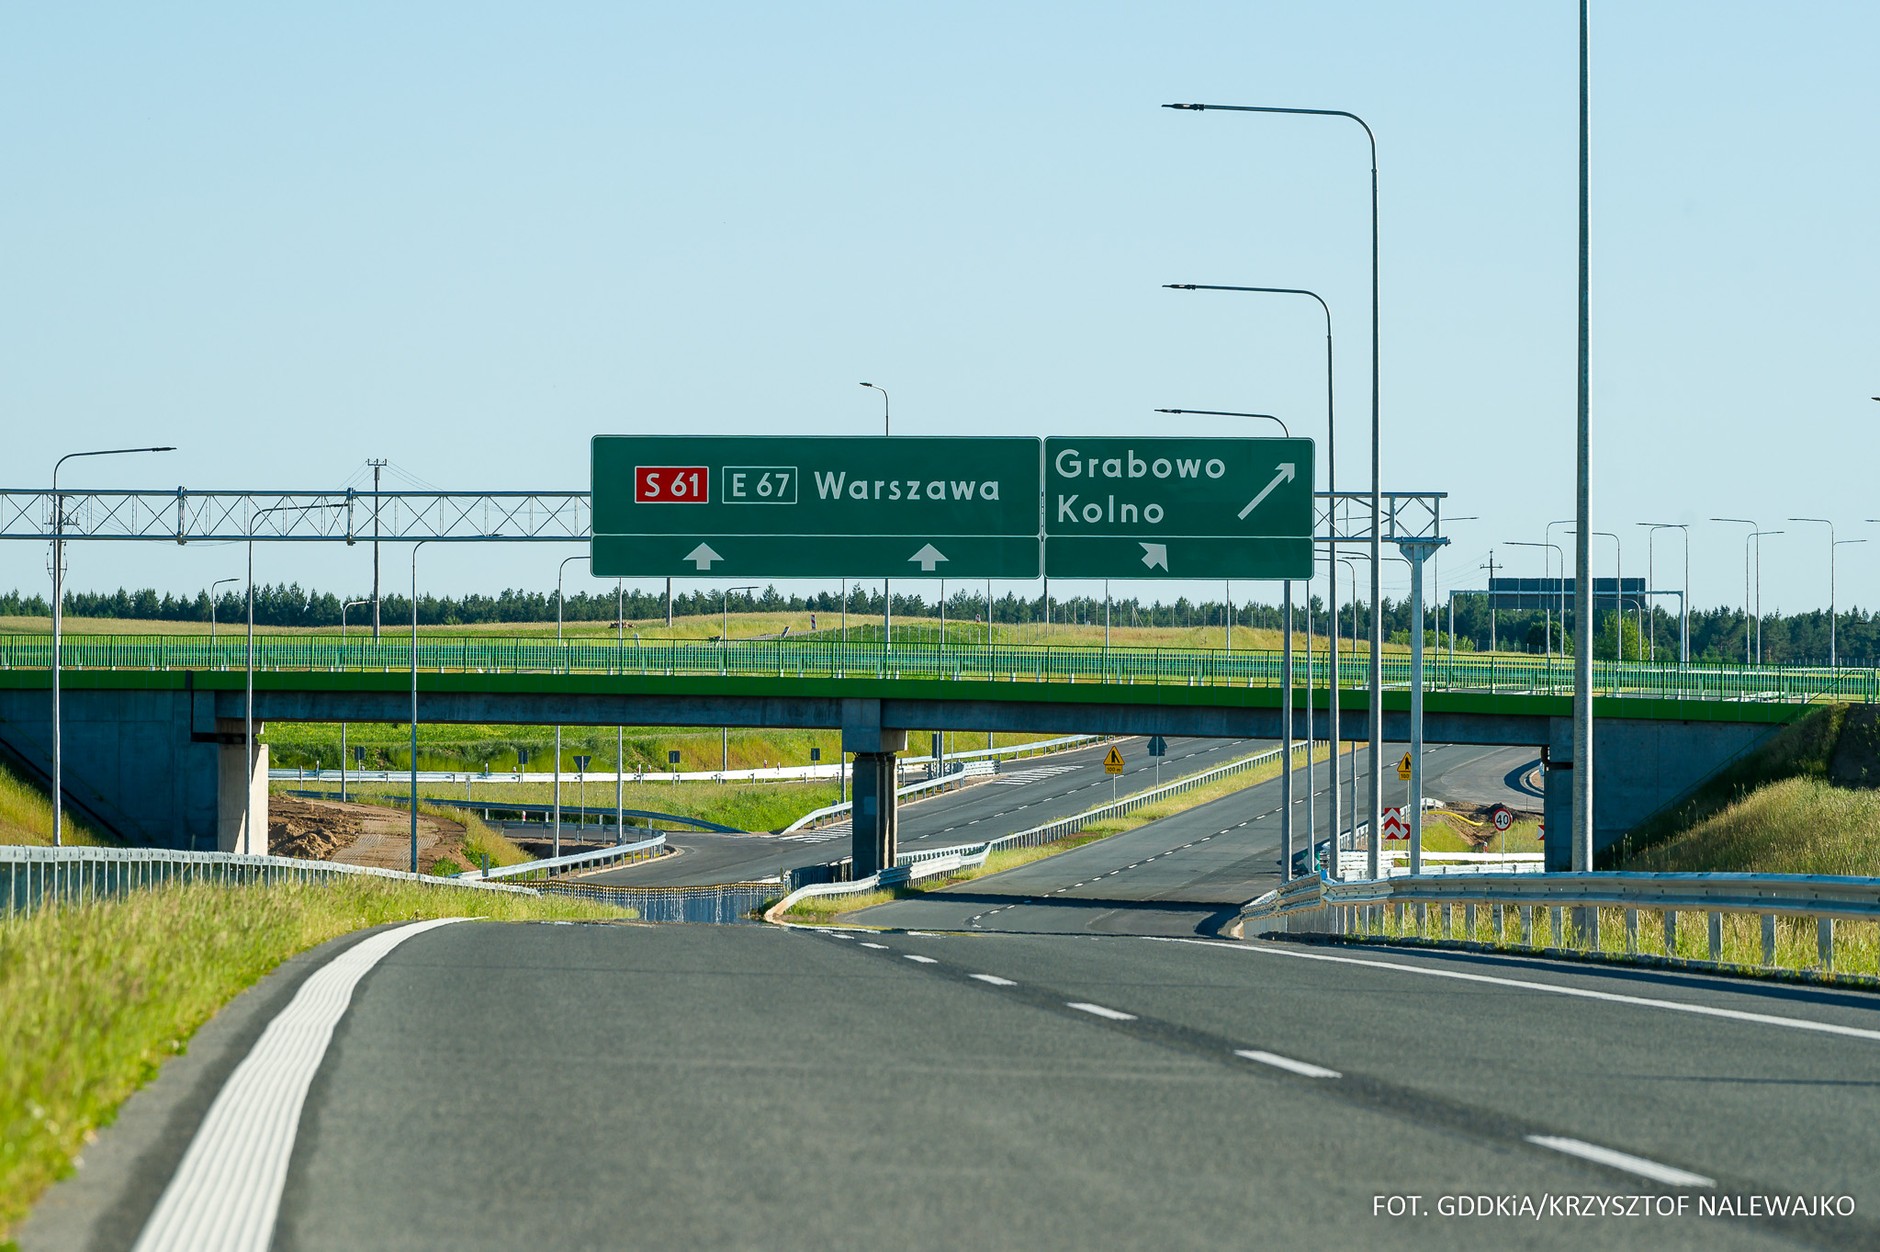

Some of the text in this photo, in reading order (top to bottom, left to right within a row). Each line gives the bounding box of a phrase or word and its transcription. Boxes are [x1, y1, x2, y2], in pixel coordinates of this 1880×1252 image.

[1055, 448, 1226, 479] Grabowo
[644, 472, 699, 498] S 61
[733, 472, 790, 498] E 67
[814, 471, 1000, 501] Warszawa
[1057, 494, 1165, 524] Kolno
[1496, 814, 1509, 825] 40
